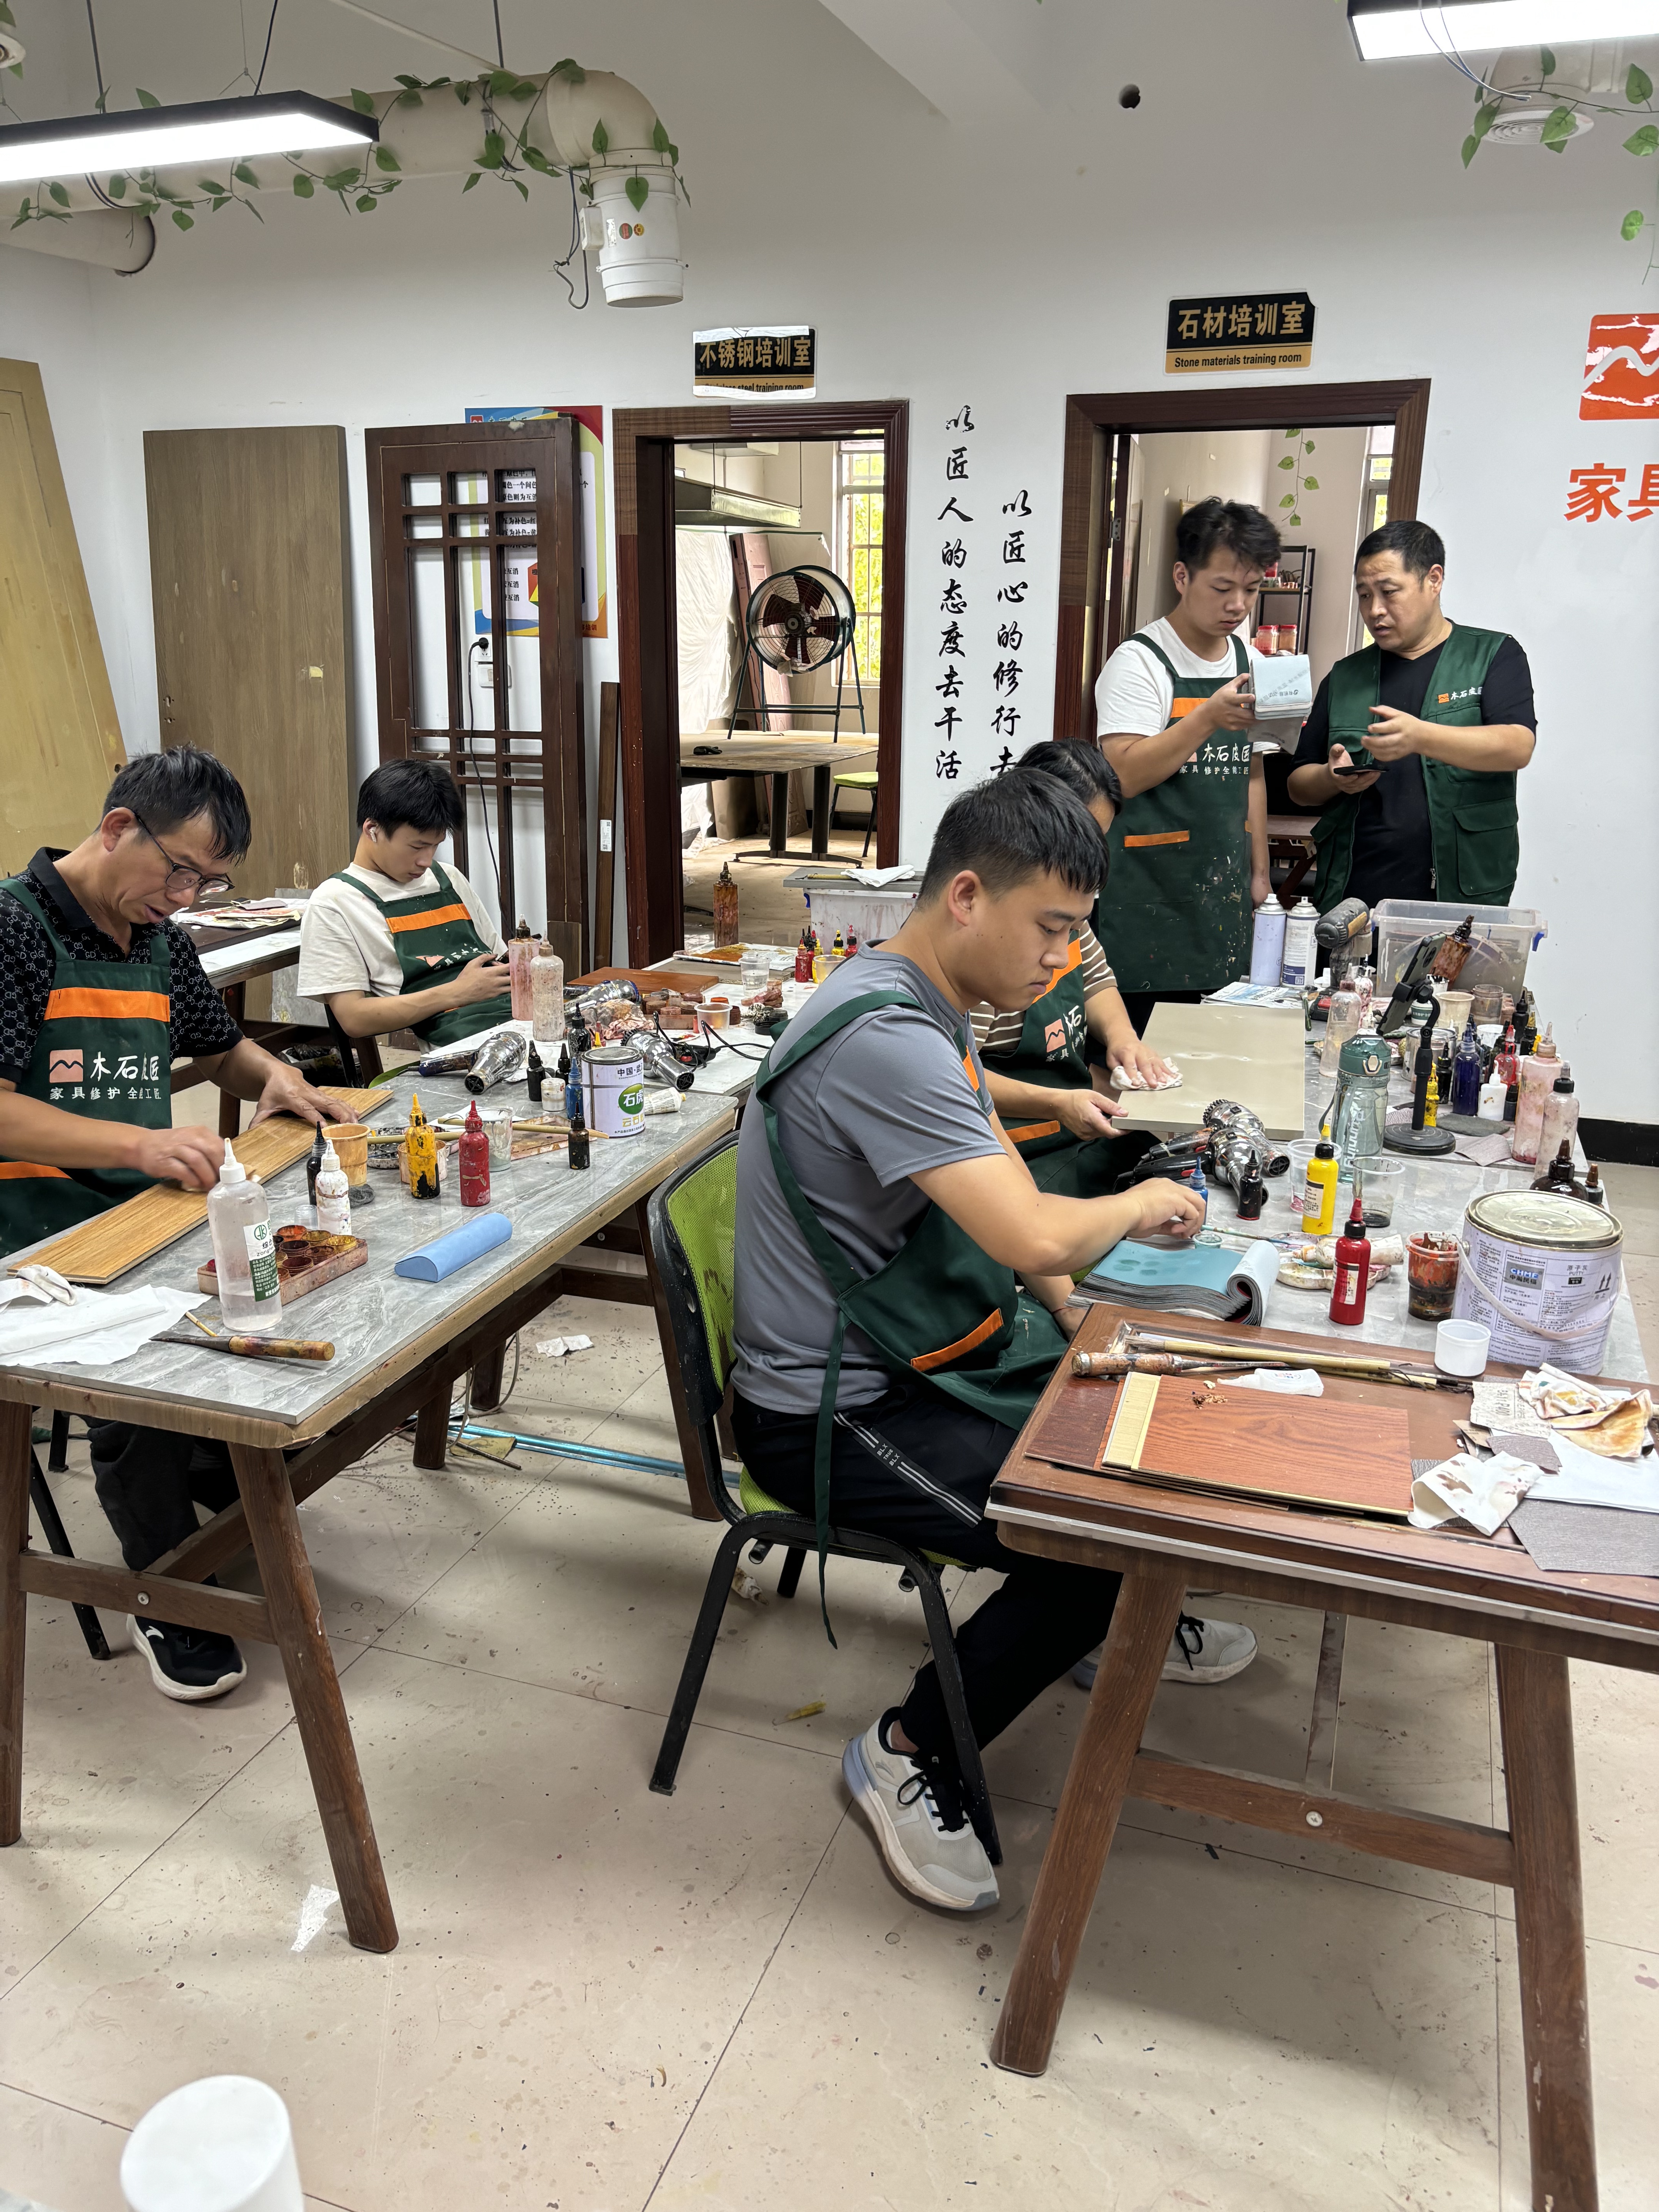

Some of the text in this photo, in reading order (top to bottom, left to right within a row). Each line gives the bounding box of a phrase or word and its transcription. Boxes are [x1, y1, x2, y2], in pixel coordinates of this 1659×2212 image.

[1178, 301, 1305, 340] 石材培训室
[700, 337, 811, 368] 不锈钢培训室
[1175, 353, 1302, 367] Stone materials training room
[935, 405, 974, 779] 以匠人的态度去干活
[990, 490, 1032, 776] 以匠心的修行去
[877, 1443, 888, 1456] BLX
[883, 1449, 893, 1460] TRUE
[889, 1453, 900, 1466] BLX
